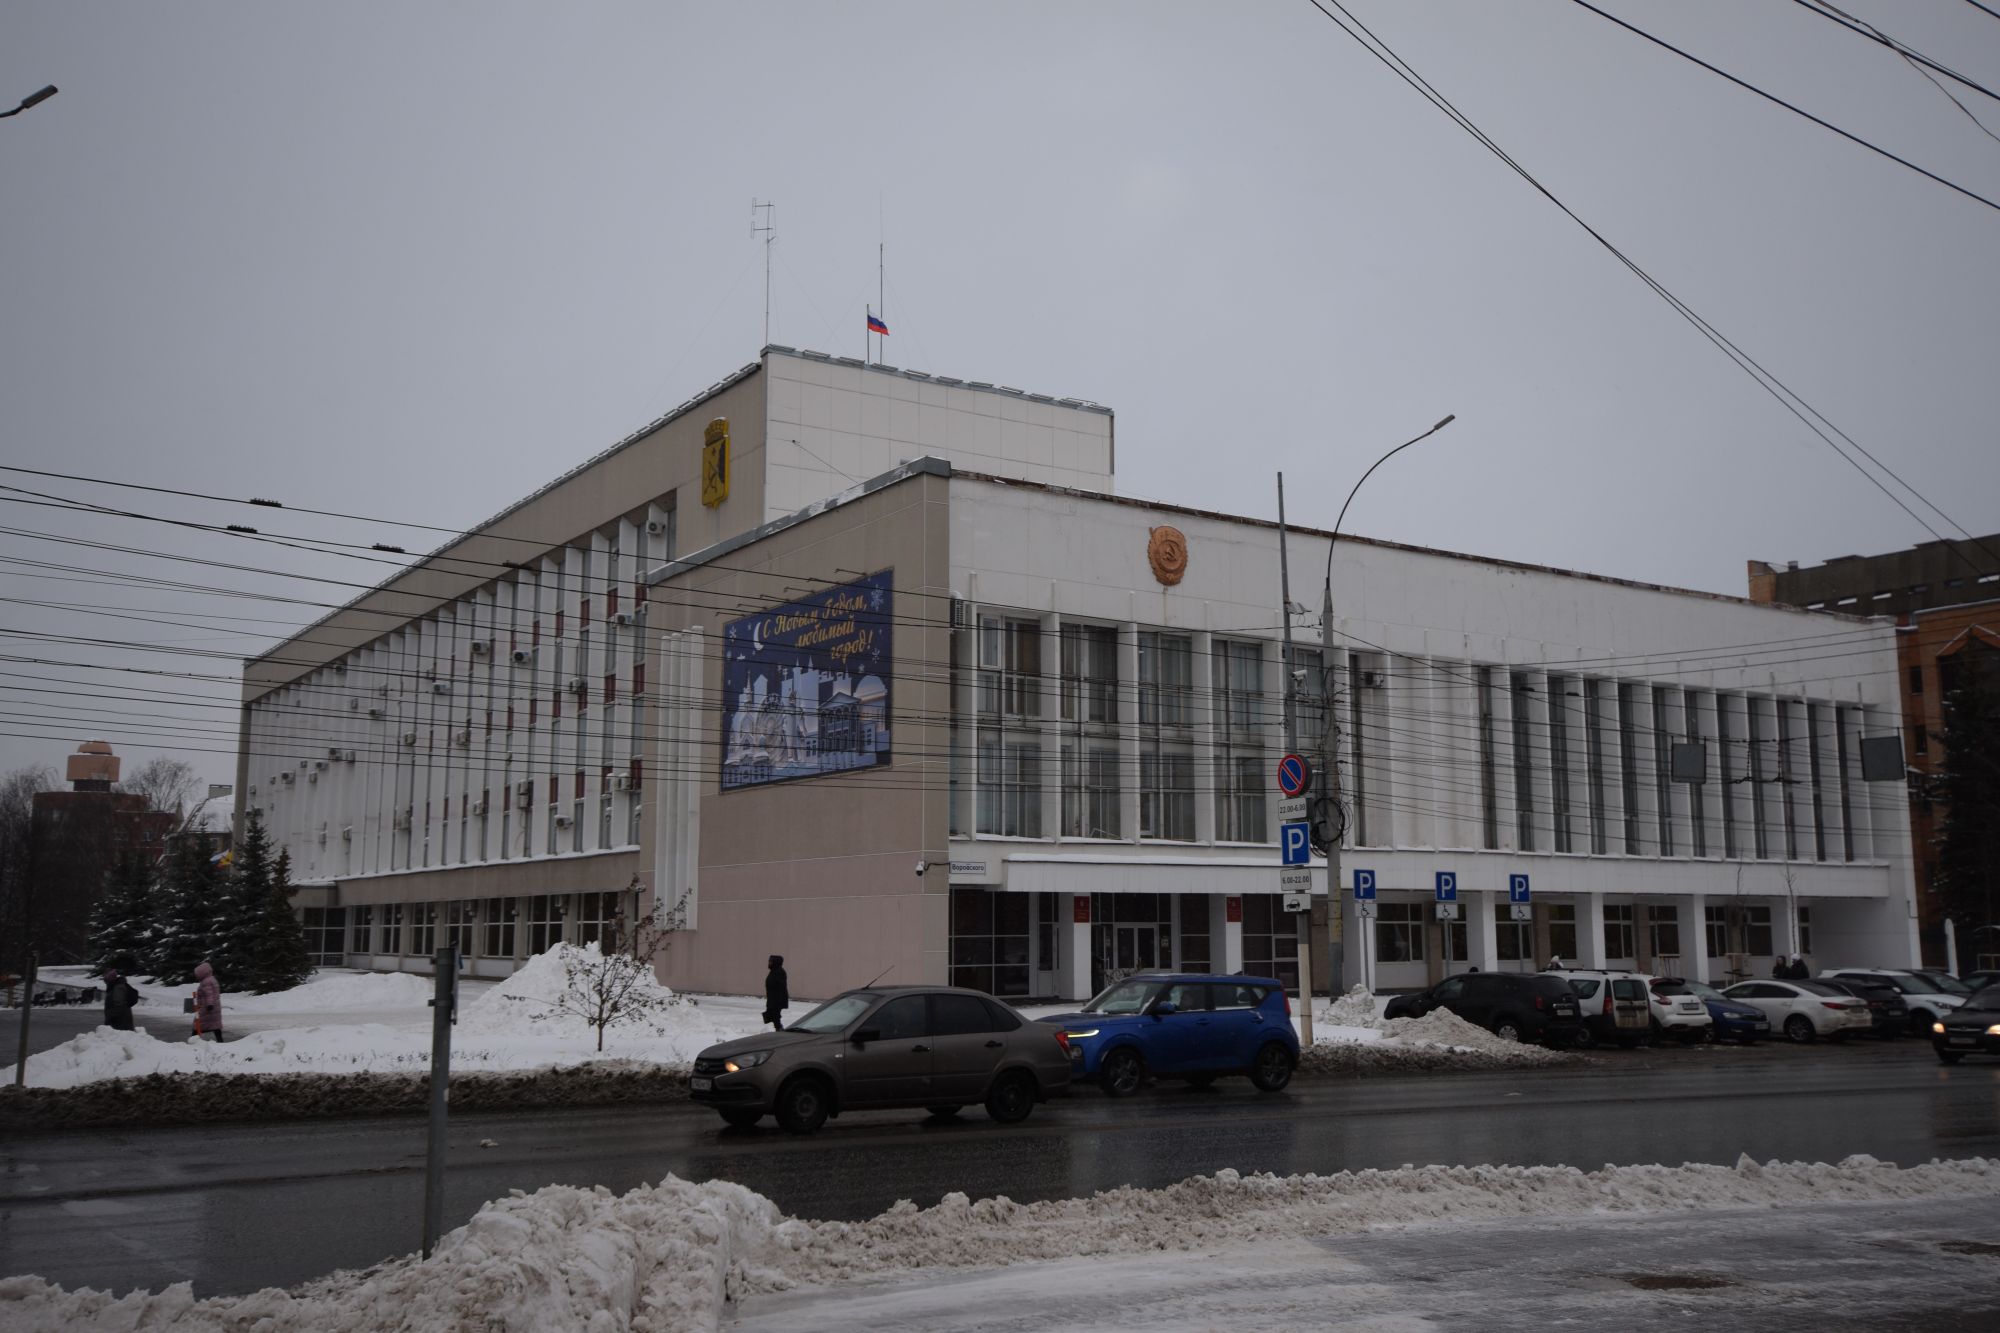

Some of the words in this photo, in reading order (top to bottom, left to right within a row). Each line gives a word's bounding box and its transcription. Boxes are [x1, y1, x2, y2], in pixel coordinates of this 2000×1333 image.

[763, 619, 772, 639] С
[774, 608, 819, 634] Новым
[822, 592, 868, 619] Годом,
[795, 614, 855, 648] любимый
[831, 629, 874, 664] город!
[1279, 803, 1306, 814] 22.00-6.00
[1287, 828, 1304, 862] P
[952, 863, 985, 871] Воровского
[1282, 876, 1310, 885] 6.00-22.00
[1360, 873, 1372, 897] P
[1441, 875, 1453, 899] P
[1515, 877, 1526, 900] P
